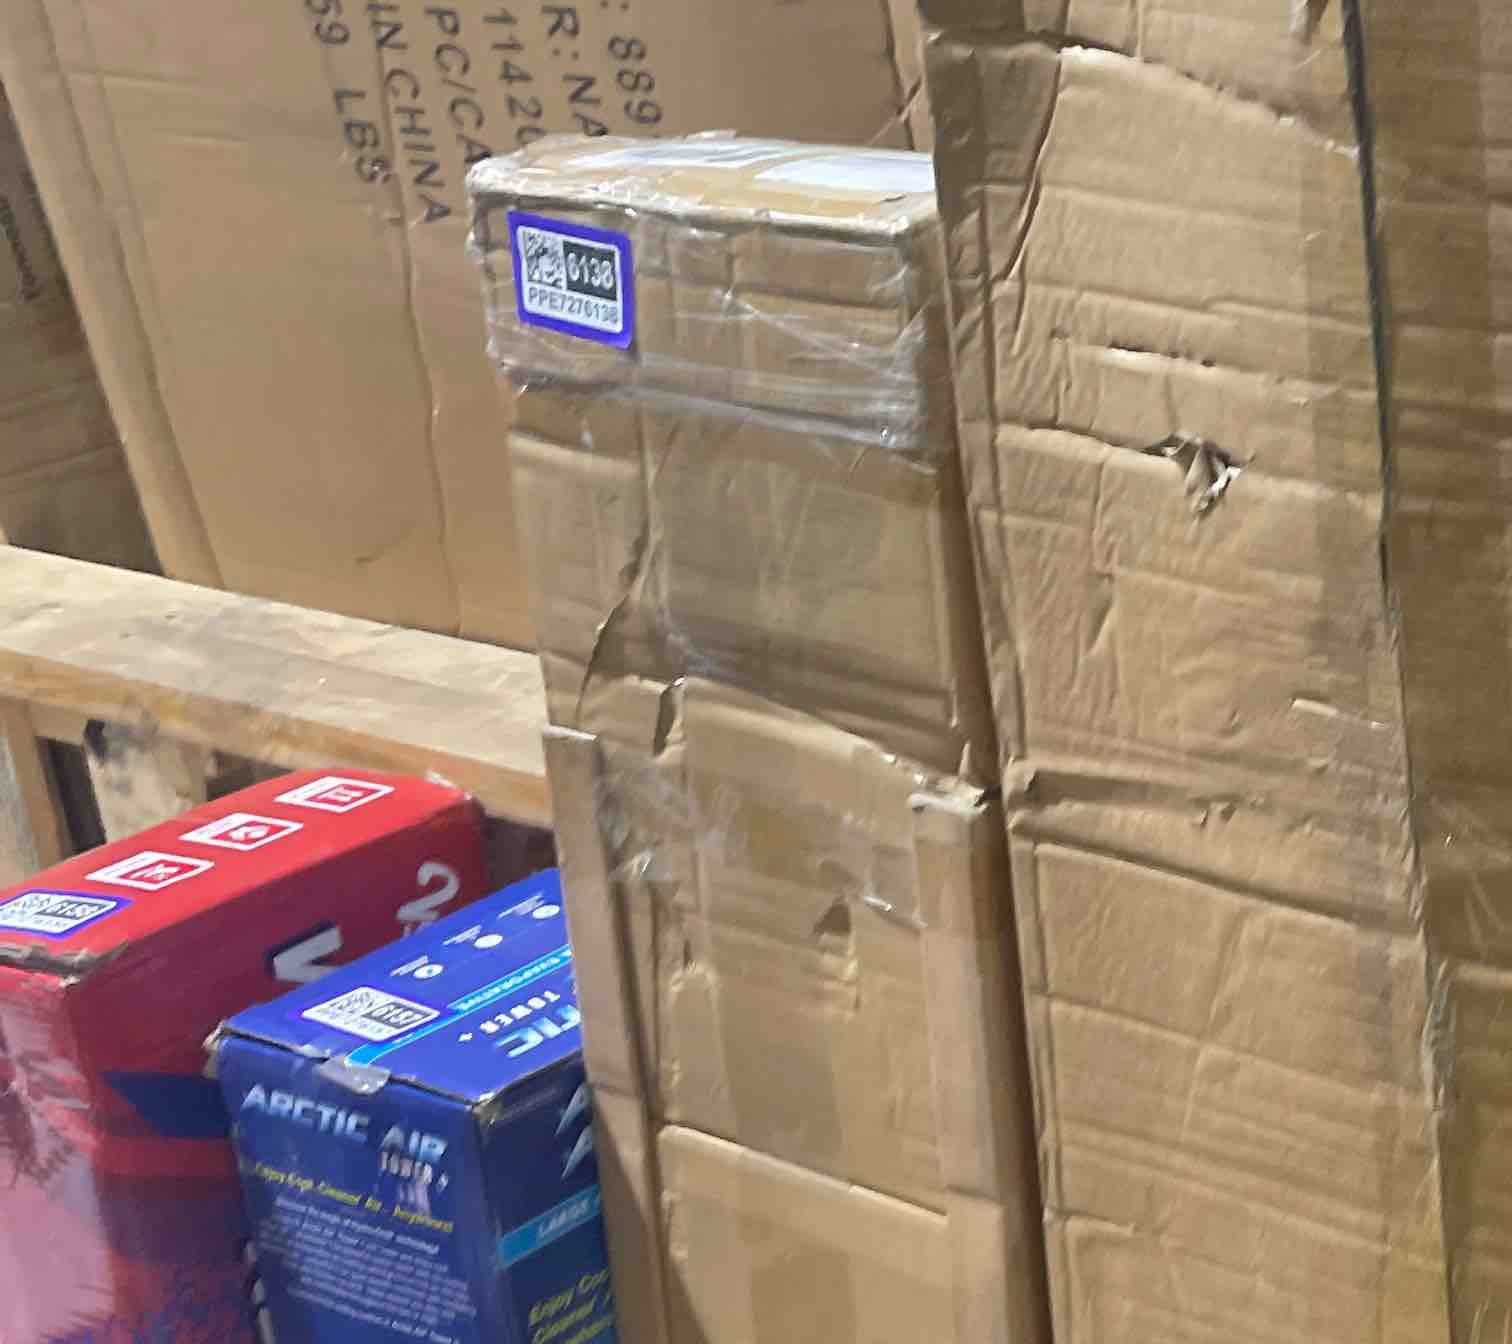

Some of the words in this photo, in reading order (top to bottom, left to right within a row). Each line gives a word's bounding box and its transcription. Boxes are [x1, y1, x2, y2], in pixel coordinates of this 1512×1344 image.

[366, 3, 408, 51] IN
[607, 33, 663, 139] 889
[383, 67, 453, 224] CHINA
[240, 1083, 369, 1144] ARCTIC
[378, 1124, 448, 1164] AIR
